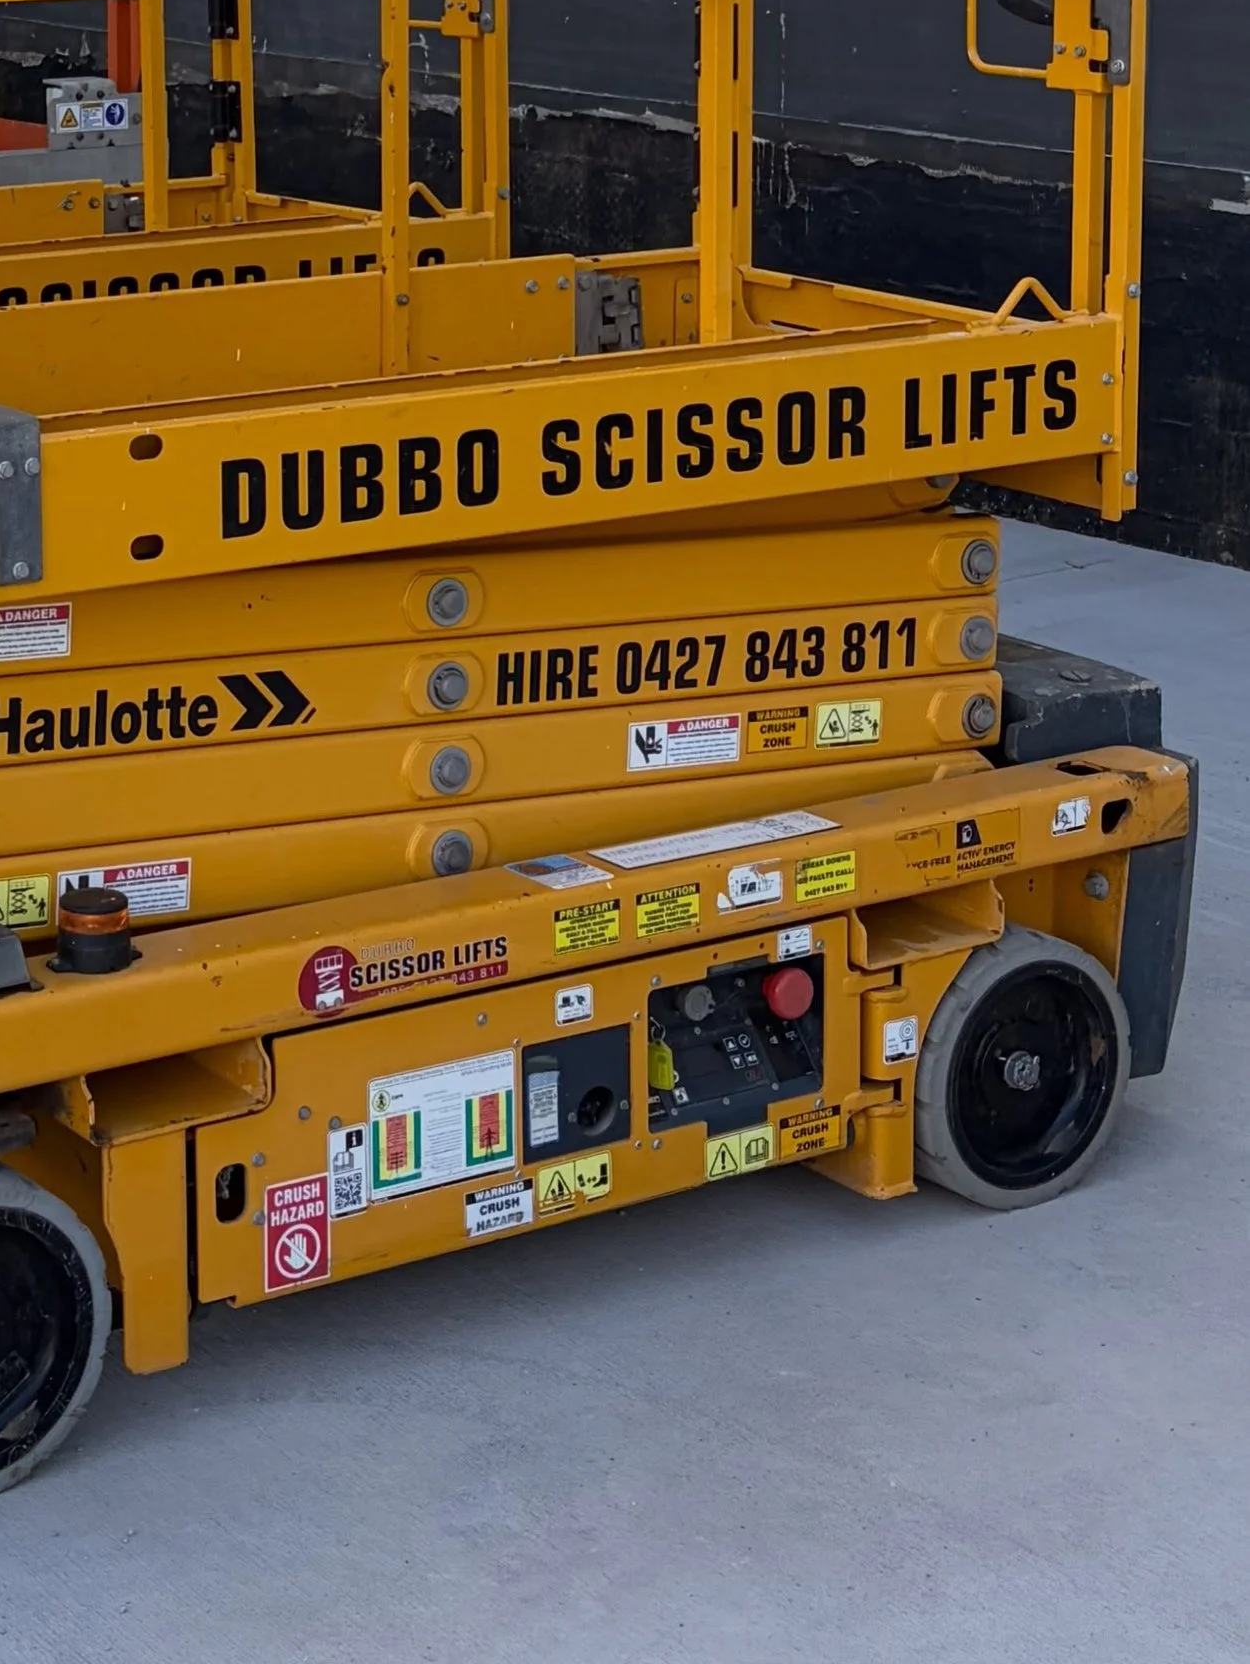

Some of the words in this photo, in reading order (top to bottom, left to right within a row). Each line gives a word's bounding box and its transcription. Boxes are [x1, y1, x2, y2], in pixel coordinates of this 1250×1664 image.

[221, 428, 500, 540] DUBBO
[541, 384, 867, 497] SCISSOR
[904, 358, 1078, 451] LIFTS
[5, 607, 58, 623] DANGER
[497, 644, 599, 706] HIRE
[616, 634, 726, 695] 0427
[745, 625, 826, 684] 843
[842, 616, 919, 673] 811
[755, 708, 800, 721] WARNING
[687, 718, 730, 732] DANGER
[759, 723, 797, 735] CRUSH
[762, 737, 792, 749] ZONE
[983, 841, 1016, 855] ENERGY
[127, 863, 178, 879] DANGER
[956, 853, 1015, 872] MANAGEMENT
[640, 884, 697, 904] ATTENTION
[559, 900, 615, 920] PRE-START
[350, 949, 446, 988] SCISSOR
[453, 936, 508, 967] LIFTS
[479, 964, 503, 979] 811
[787, 1106, 833, 1127] WARNING
[791, 1122, 829, 1140] CRUSH
[795, 1137, 826, 1154] ZONE
[273, 1181, 321, 1208] CRUSH
[474, 1181, 525, 1203] WARNING
[270, 1201, 325, 1227] HAZARD
[479, 1197, 520, 1216] CRUSH
[476, 1211, 525, 1233] HAZARD
